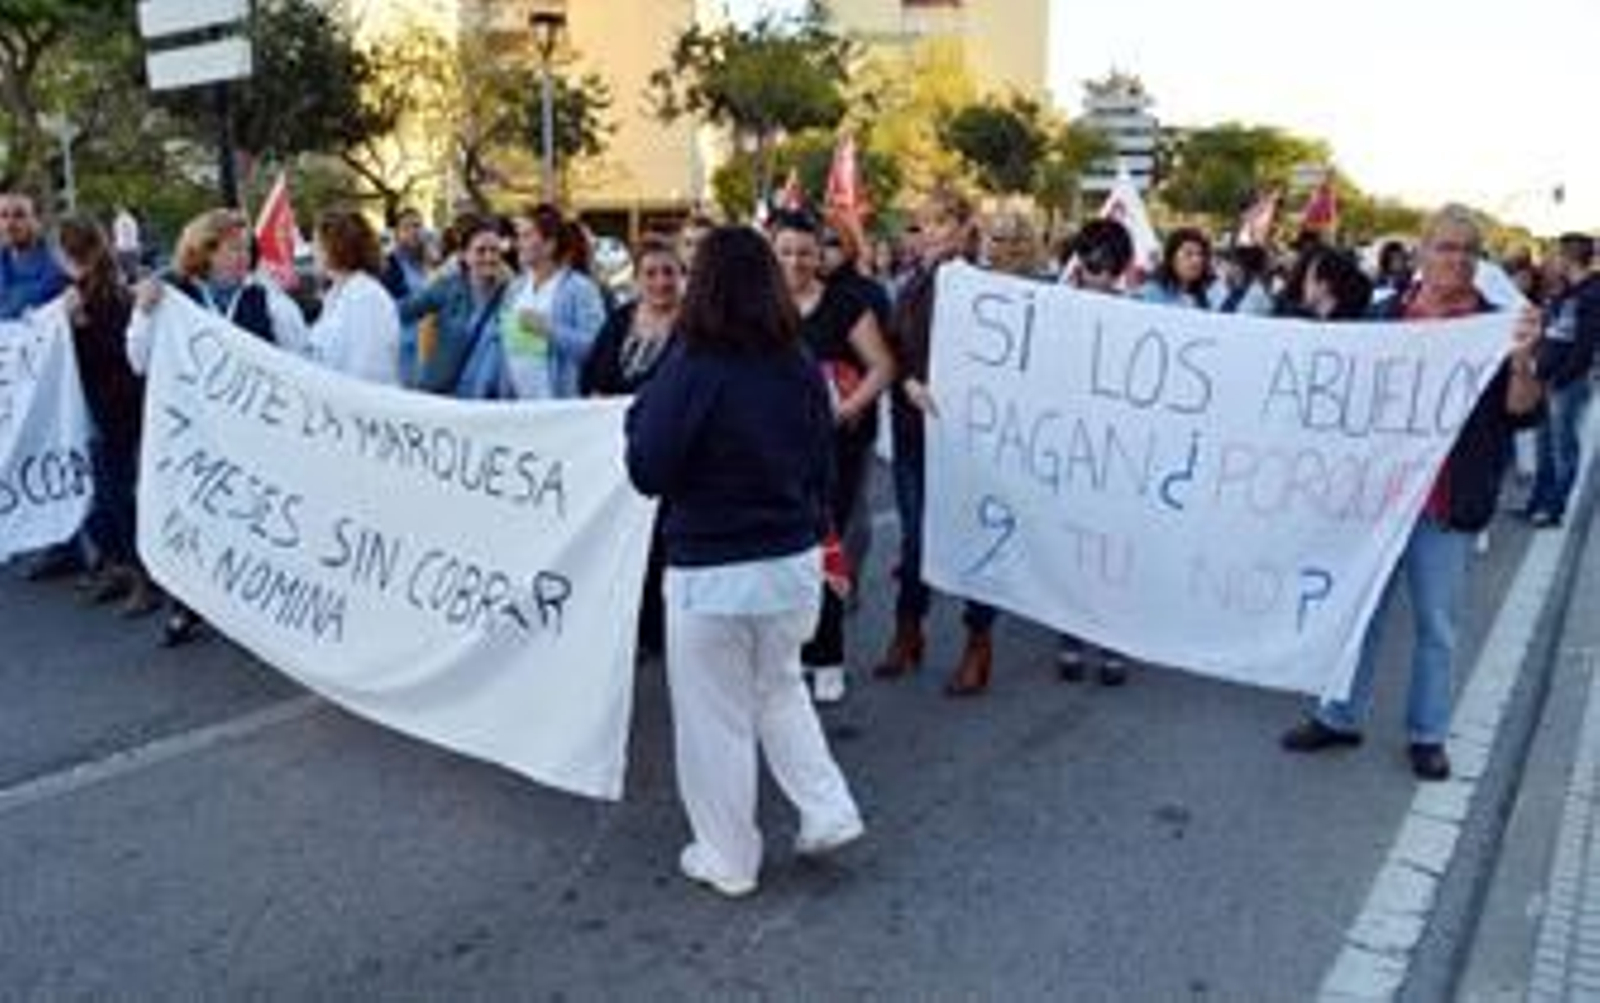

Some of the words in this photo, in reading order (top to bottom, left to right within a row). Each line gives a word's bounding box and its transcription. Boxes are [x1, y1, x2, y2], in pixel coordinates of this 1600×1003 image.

[177, 328, 290, 426] SUITE
[355, 415, 567, 521] MARQUESA
[1091, 322, 1212, 415] LOS
[173, 448, 304, 548] MESES
[321, 517, 399, 593] SIN
[408, 550, 572, 637] COBRAR
[213, 546, 347, 644] NOMINA
